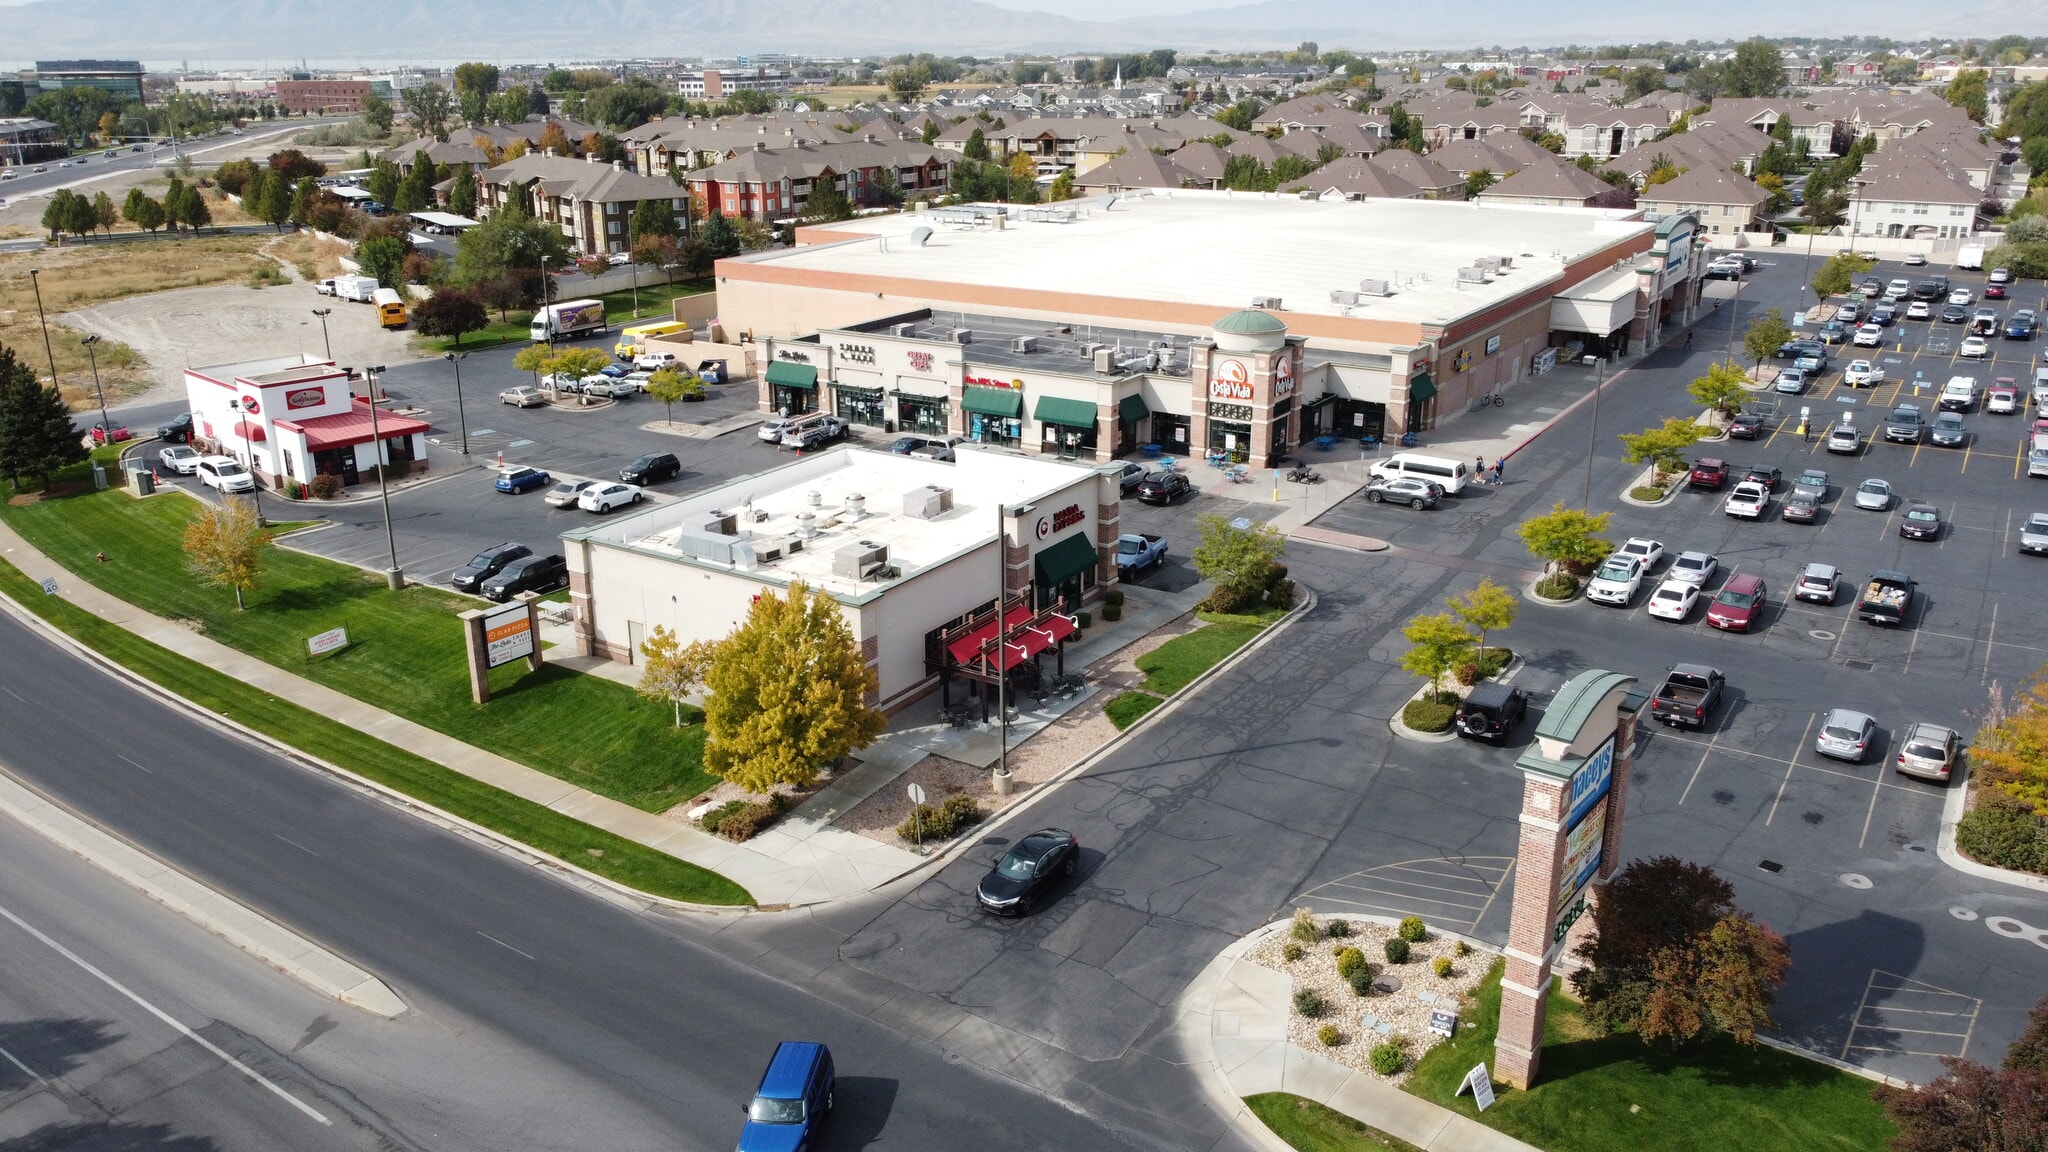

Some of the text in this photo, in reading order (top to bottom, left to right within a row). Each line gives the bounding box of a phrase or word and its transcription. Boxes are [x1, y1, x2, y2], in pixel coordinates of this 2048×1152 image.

[907, 350, 931, 360] GREAT
[1210, 380, 1251, 398] Costa Vida
[47, 584, 58, 593] 40
[512, 622, 528, 631] PIZZA
